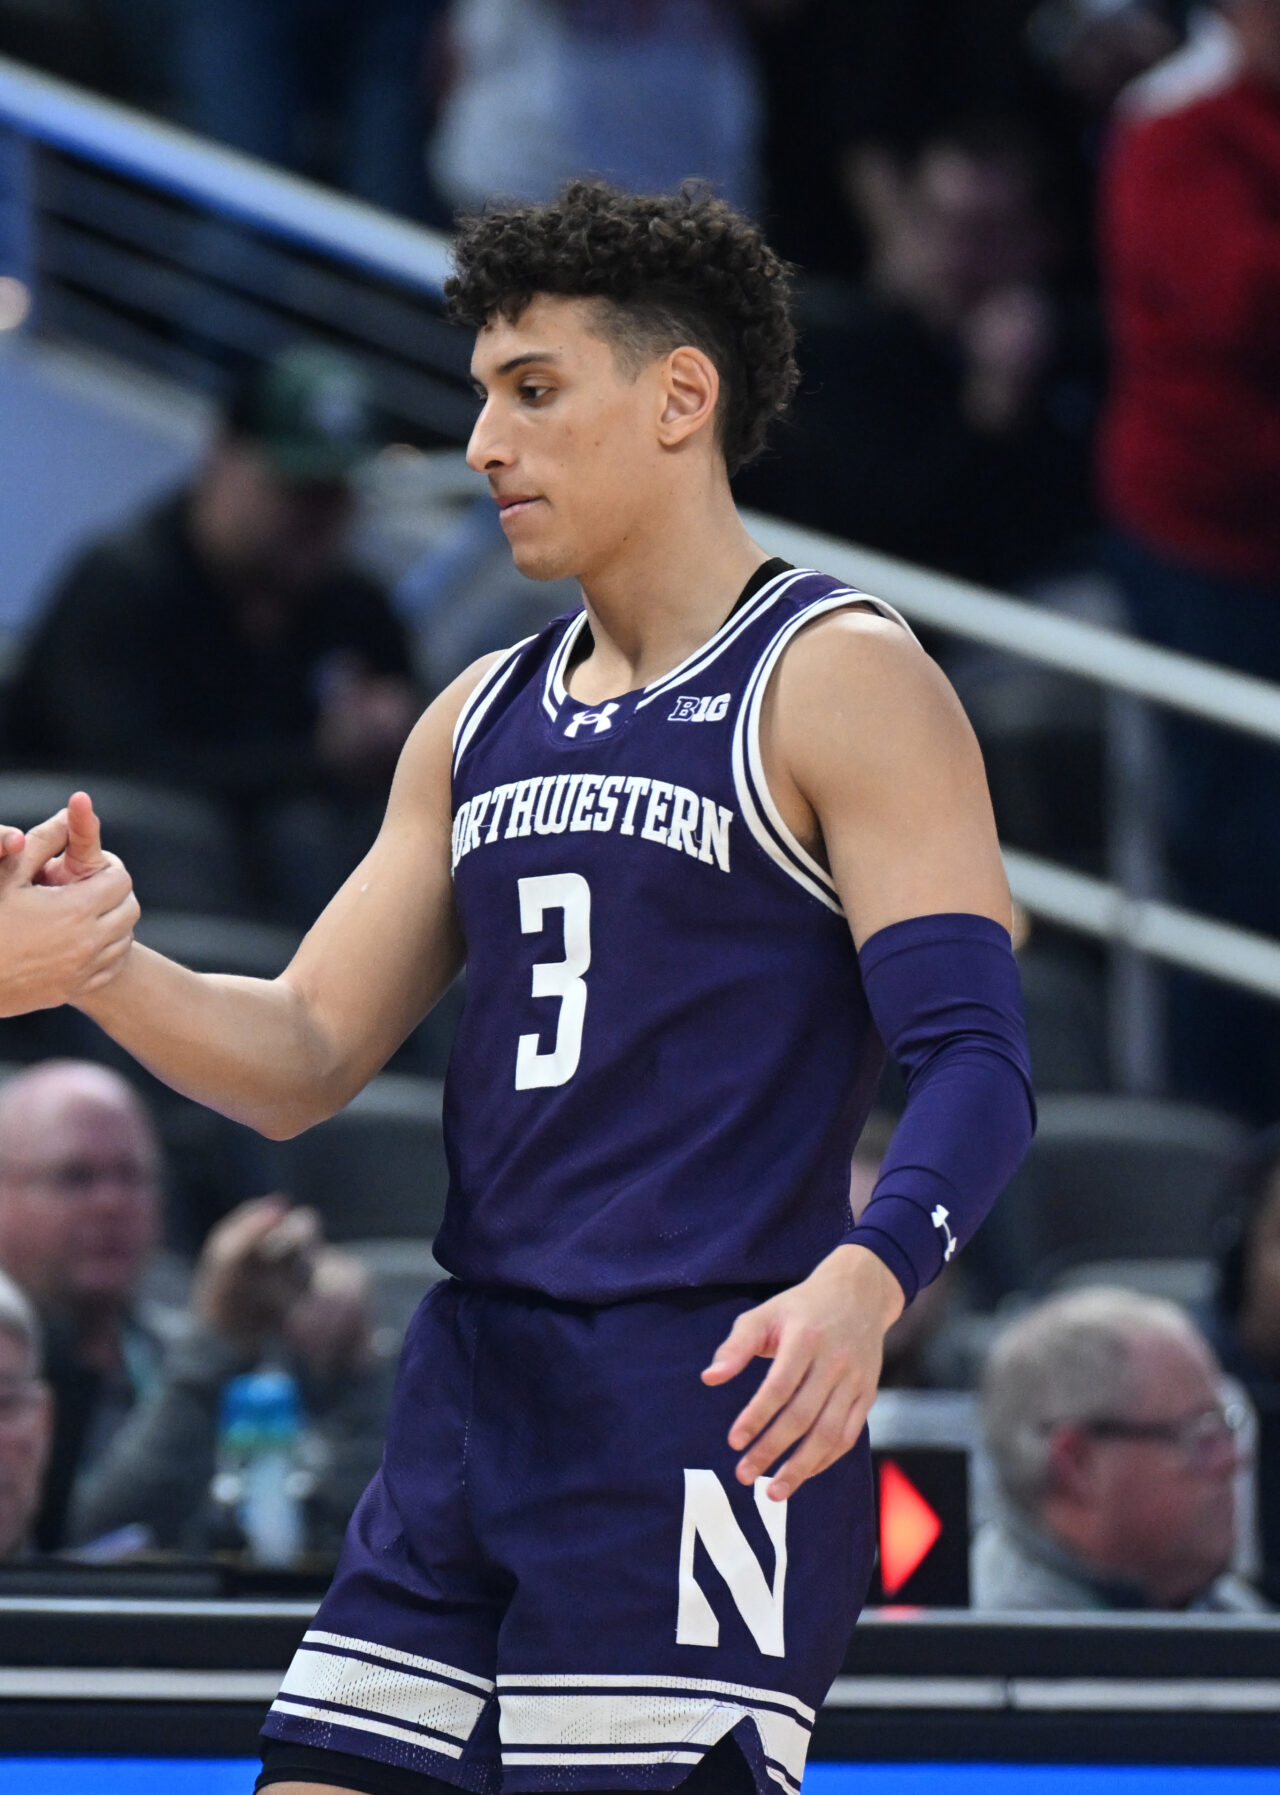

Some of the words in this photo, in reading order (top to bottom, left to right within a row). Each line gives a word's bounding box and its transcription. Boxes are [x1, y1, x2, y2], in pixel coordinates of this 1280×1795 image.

[451, 773, 733, 872] ORTHWESTERN
[515, 873, 591, 1090] 3
[676, 1468, 788, 1658] N
